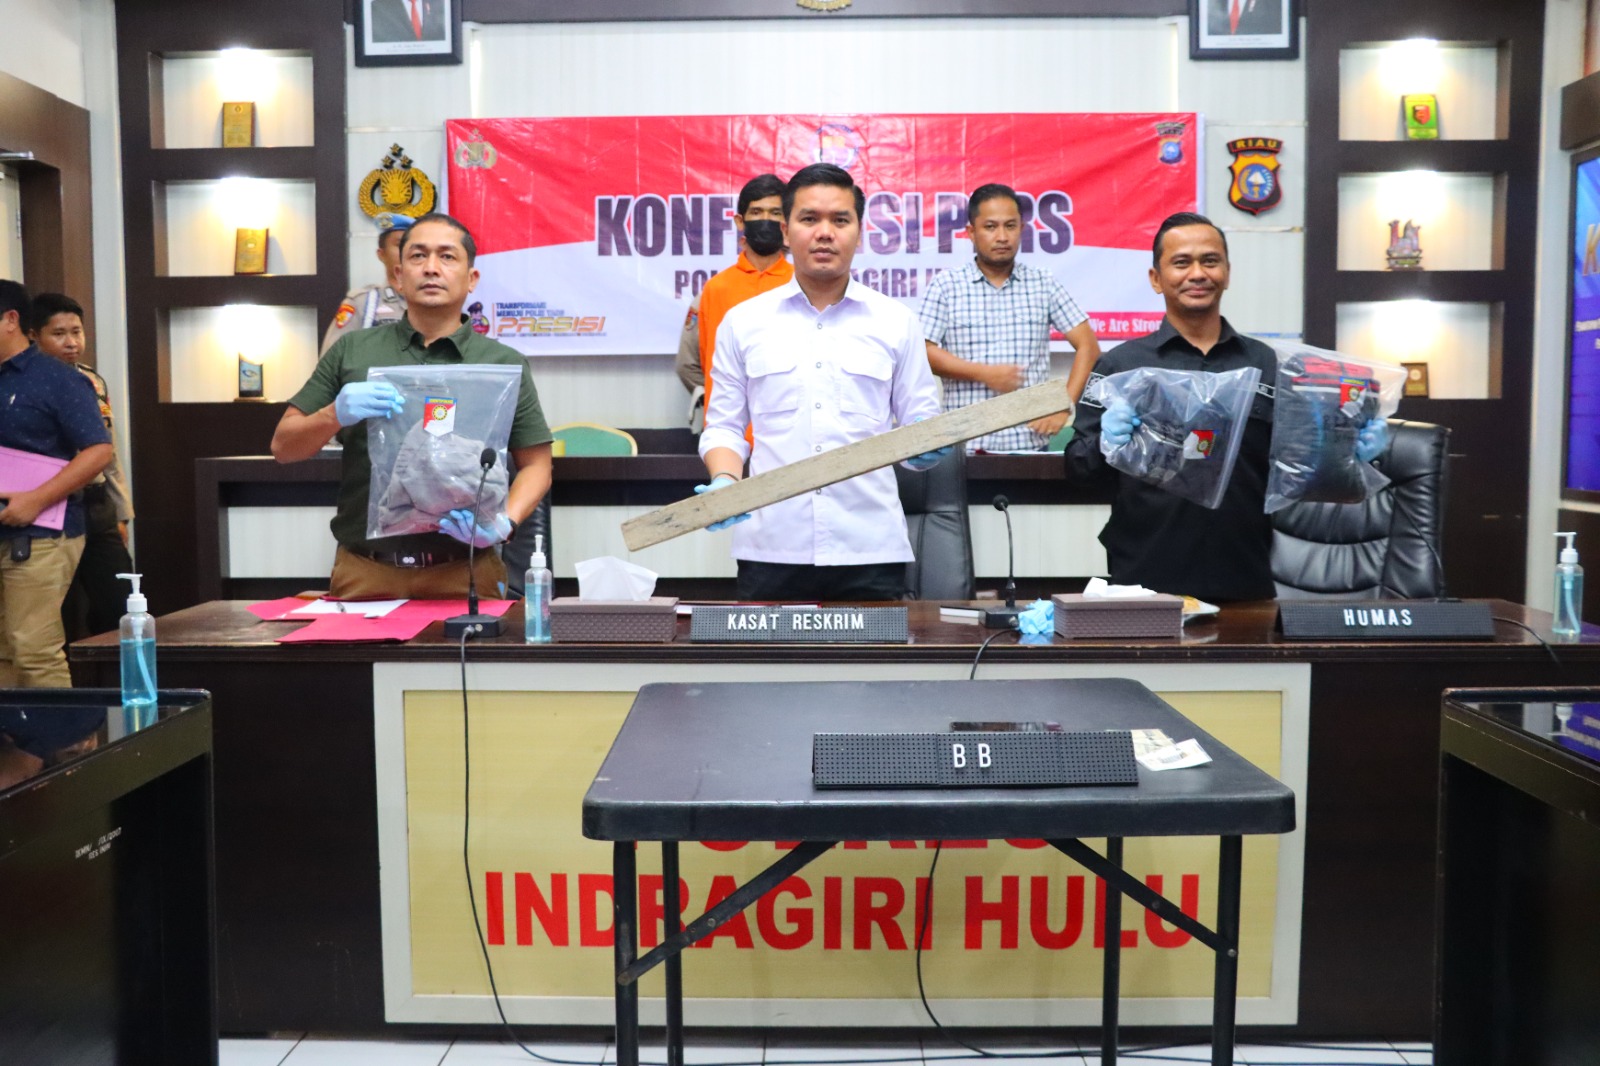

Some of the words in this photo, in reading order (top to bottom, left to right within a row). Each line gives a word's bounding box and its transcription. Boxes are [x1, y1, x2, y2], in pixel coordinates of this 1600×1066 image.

[1236, 139, 1277, 149] RIAU
[598, 193, 920, 257] KONFSI
[497, 316, 606, 333] PRESISI
[1108, 318, 1130, 333] Are
[727, 613, 779, 630] KASAT
[793, 613, 864, 630] RESKRIM
[1343, 608, 1412, 626] HUMAS
[485, 871, 933, 951] INDRAGIRI
[964, 874, 1199, 949] HULU
